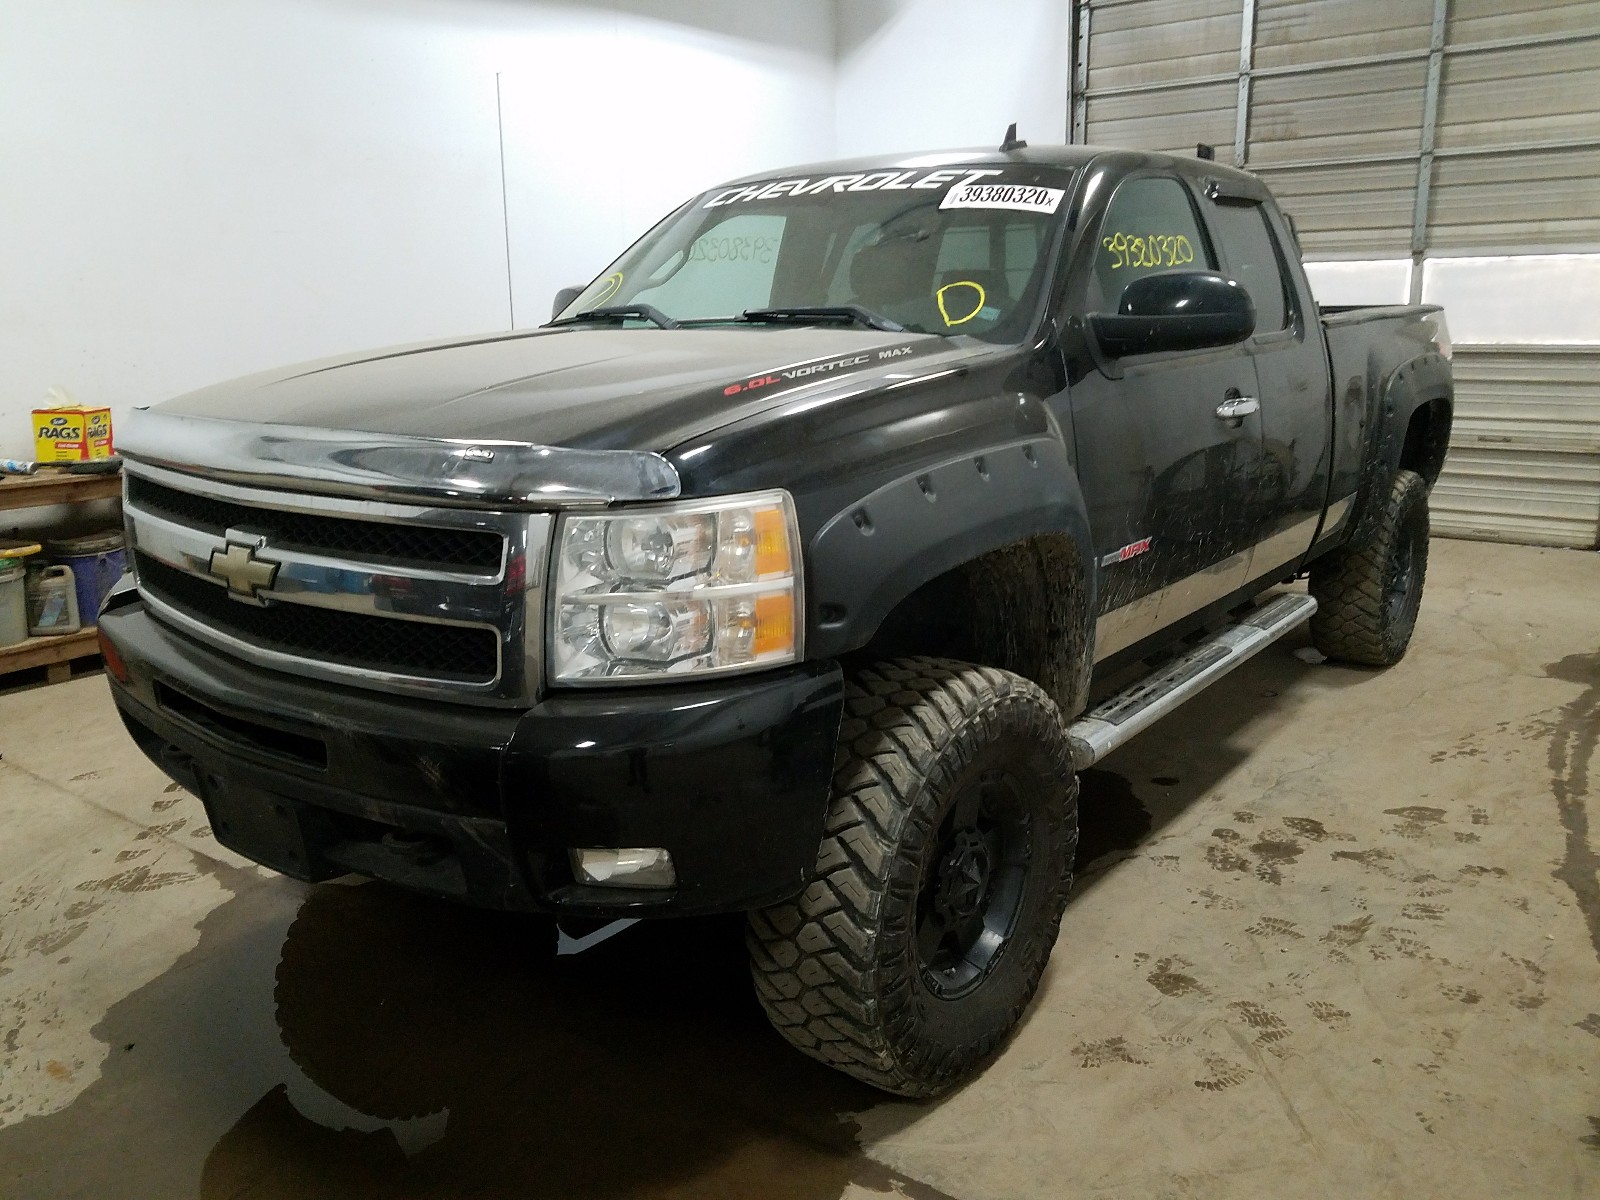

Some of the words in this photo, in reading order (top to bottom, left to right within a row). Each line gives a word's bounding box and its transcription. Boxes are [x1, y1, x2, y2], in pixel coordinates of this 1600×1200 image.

[703, 168, 1003, 209] CHEVROLET
[723, 376, 781, 396] 6.0L
[782, 355, 869, 378] VORTEC
[878, 346, 912, 360] MAX
[38, 427, 80, 439] RAGS
